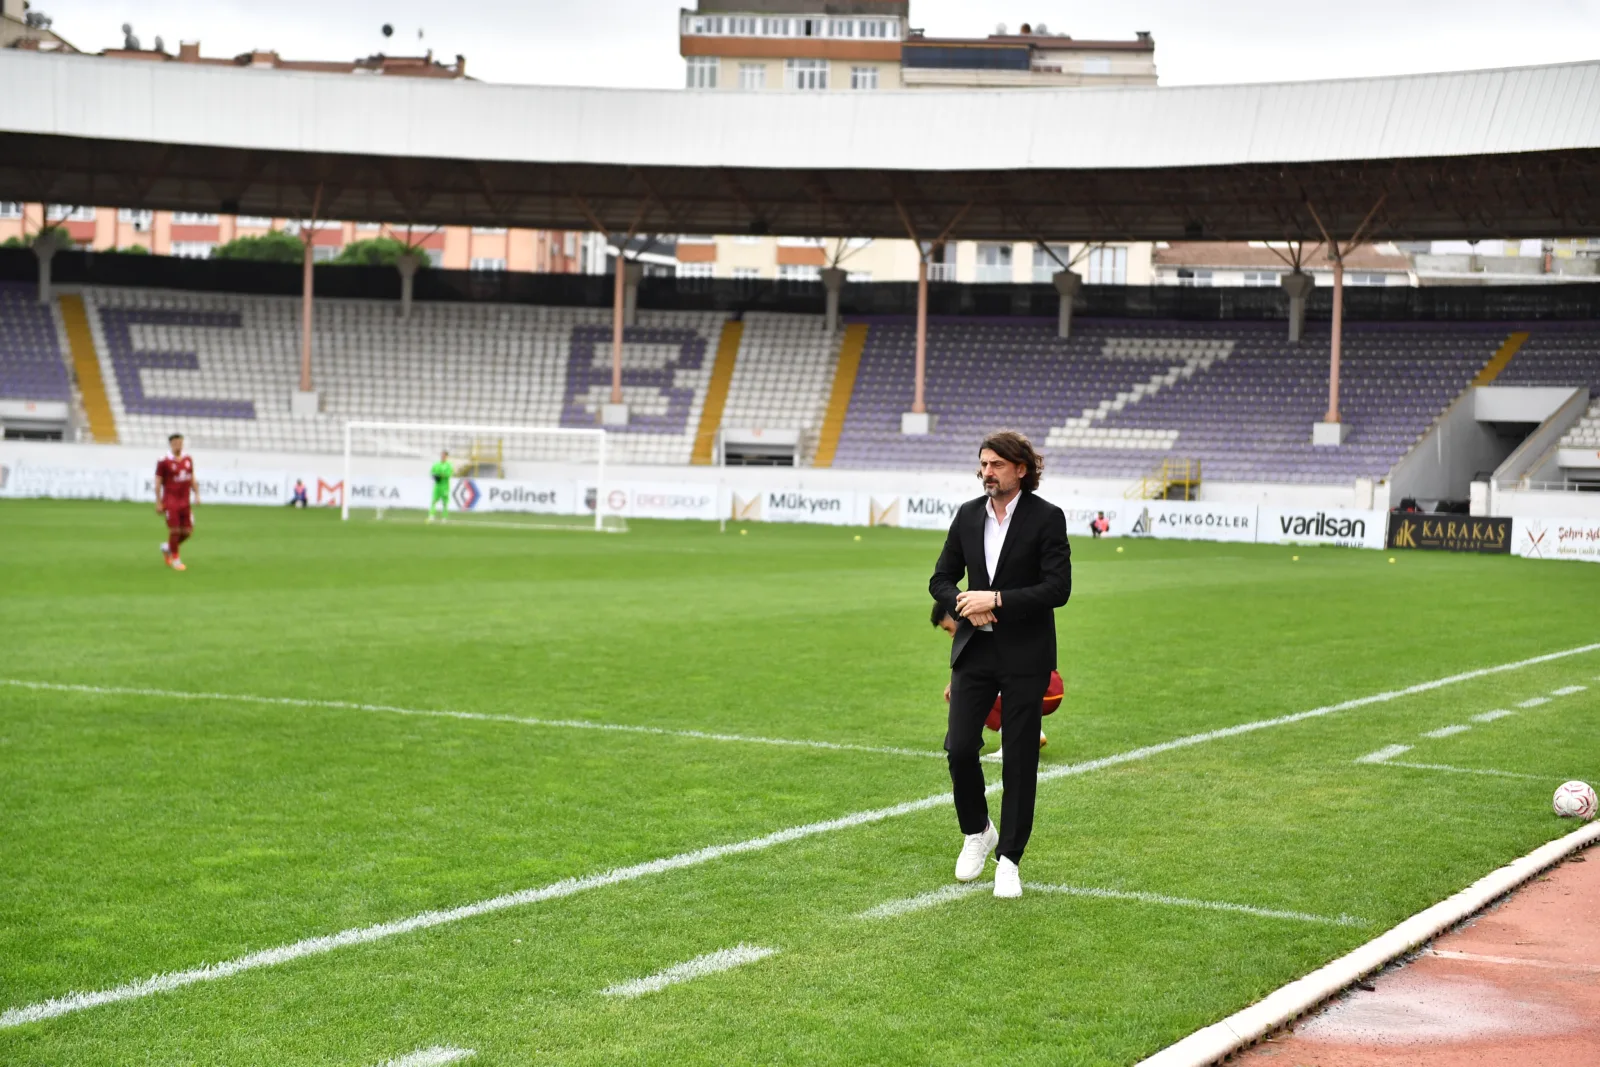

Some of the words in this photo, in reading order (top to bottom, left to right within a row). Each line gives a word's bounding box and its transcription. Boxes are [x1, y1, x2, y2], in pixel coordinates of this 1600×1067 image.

[489, 487, 556, 504] Polinet
[769, 493, 841, 513] Mükyen
[907, 498, 959, 519] Müky
[1158, 512, 1249, 528] AÇIKGÖZLER
[1280, 511, 1365, 538] varilsan
[1422, 520, 1506, 544] KARAKAŞ
